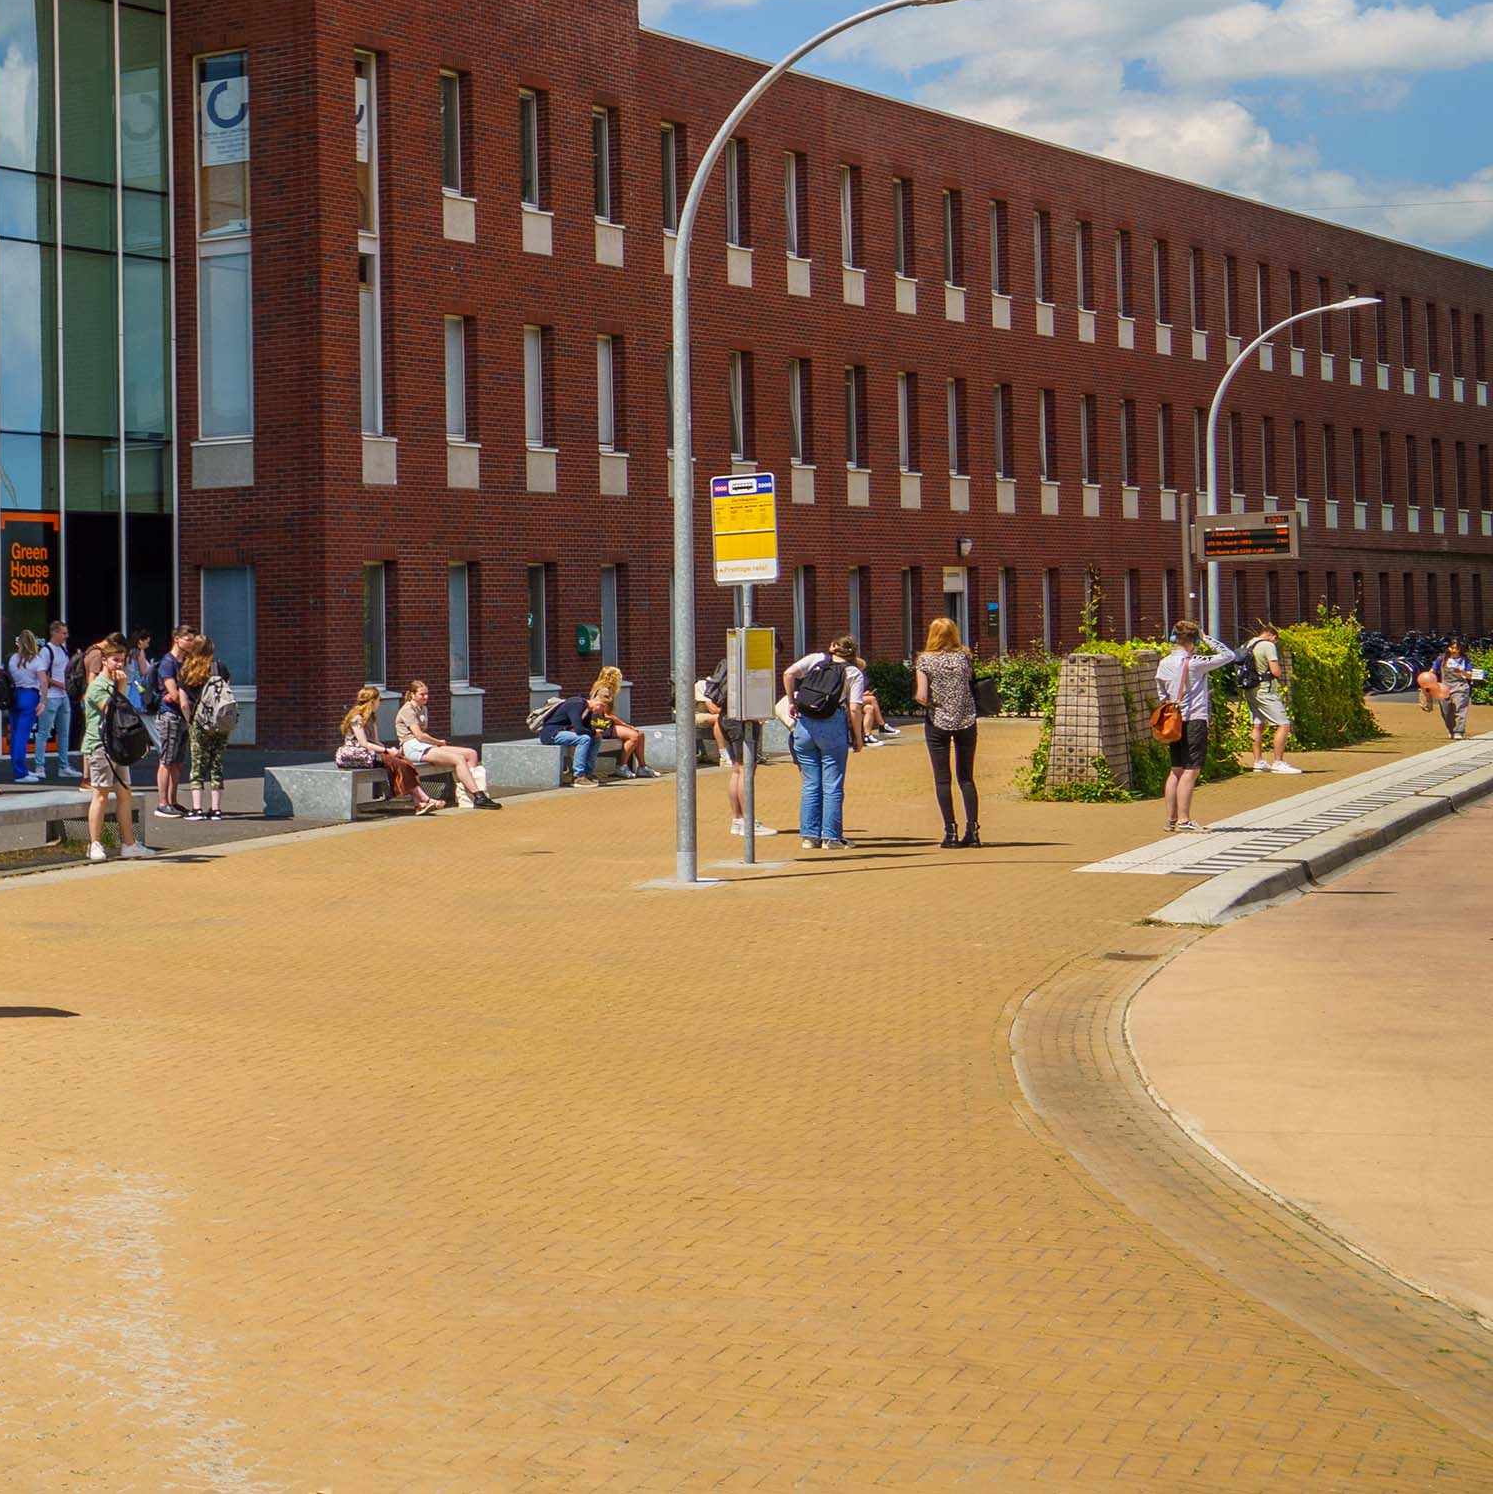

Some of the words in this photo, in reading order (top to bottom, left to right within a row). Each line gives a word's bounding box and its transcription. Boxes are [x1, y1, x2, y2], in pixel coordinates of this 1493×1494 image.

[11, 541, 48, 560] Green
[10, 561, 50, 578] House
[10, 578, 50, 596] Studio
